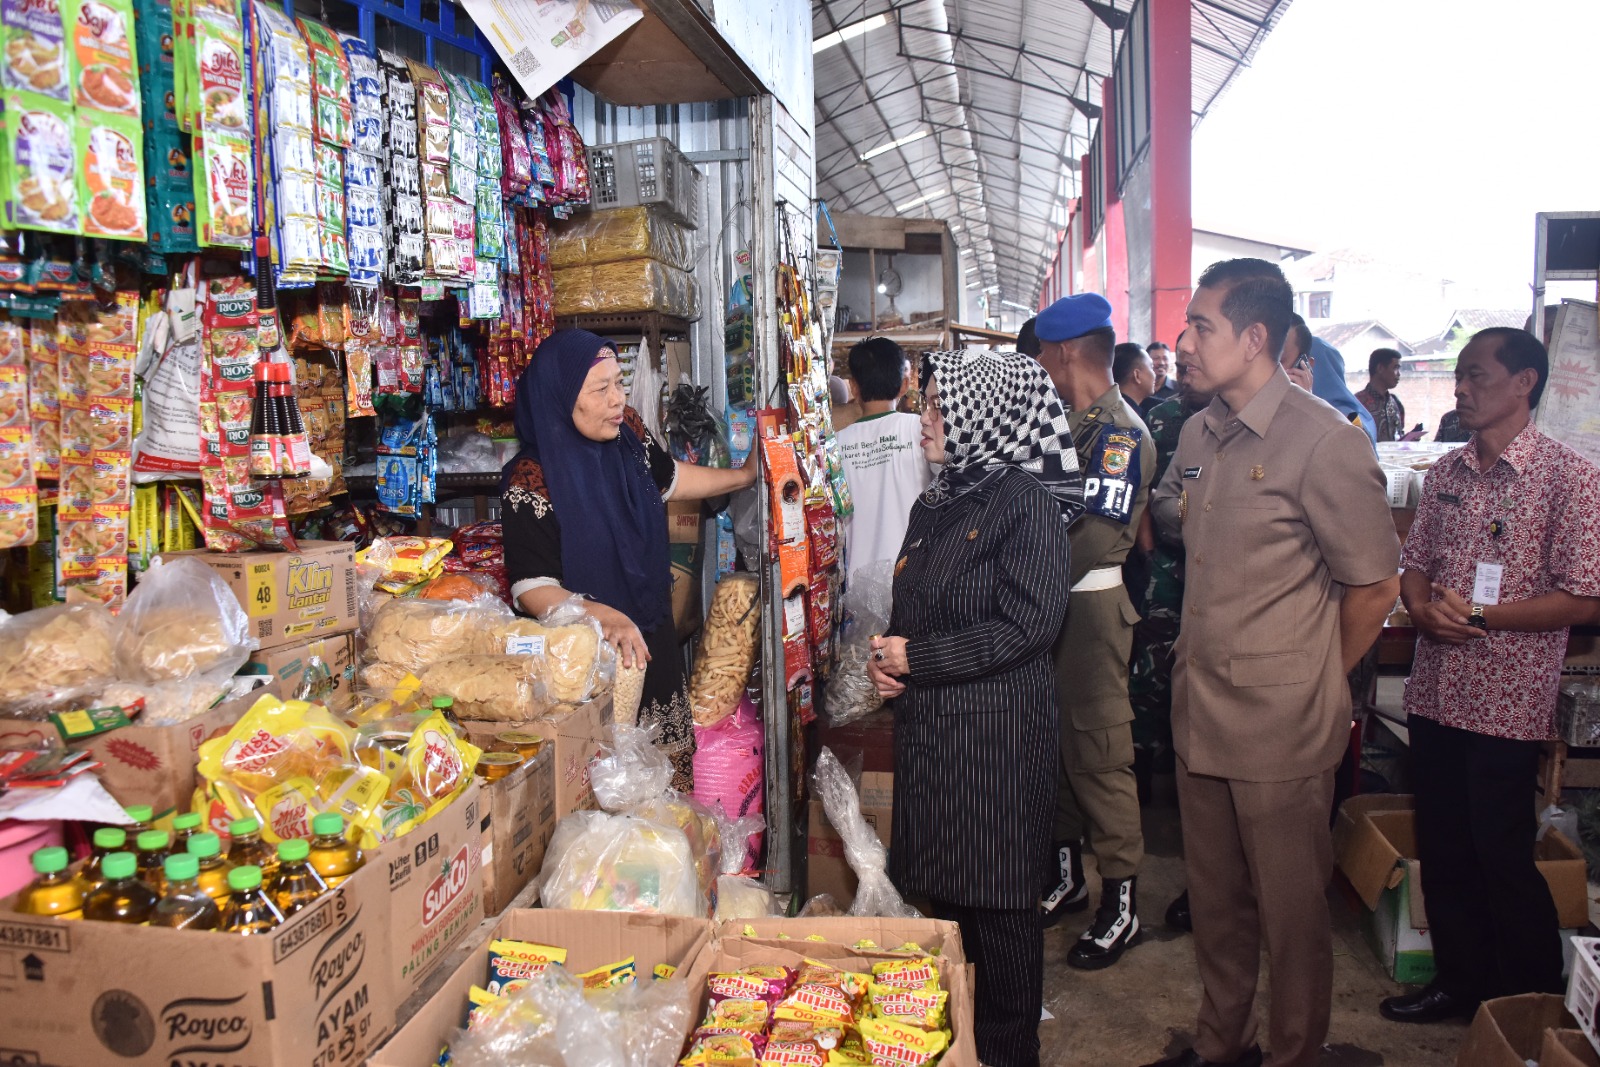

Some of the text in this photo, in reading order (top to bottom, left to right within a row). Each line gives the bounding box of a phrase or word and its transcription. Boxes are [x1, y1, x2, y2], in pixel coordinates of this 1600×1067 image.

[219, 301, 251, 312] SAORI
[221, 366, 254, 377] SAORI
[232, 493, 262, 506] SAORI
[212, 505, 227, 516] ORI
[286, 562, 334, 597] Klin
[256, 586, 271, 604] 48
[288, 589, 332, 610] Lantai
[424, 859, 466, 921] SunCo
[280, 908, 328, 955] 64387881
[411, 925, 439, 956] MINYAK
[313, 932, 363, 1002] Royco
[401, 940, 439, 979] PALING
[712, 985, 757, 1000] GELAS
[802, 983, 845, 999] GELAS
[317, 983, 369, 1048] AYAM
[882, 1003, 927, 1019] GELAS
[165, 1012, 248, 1042] Royco
[769, 1043, 816, 1053] GELAS
